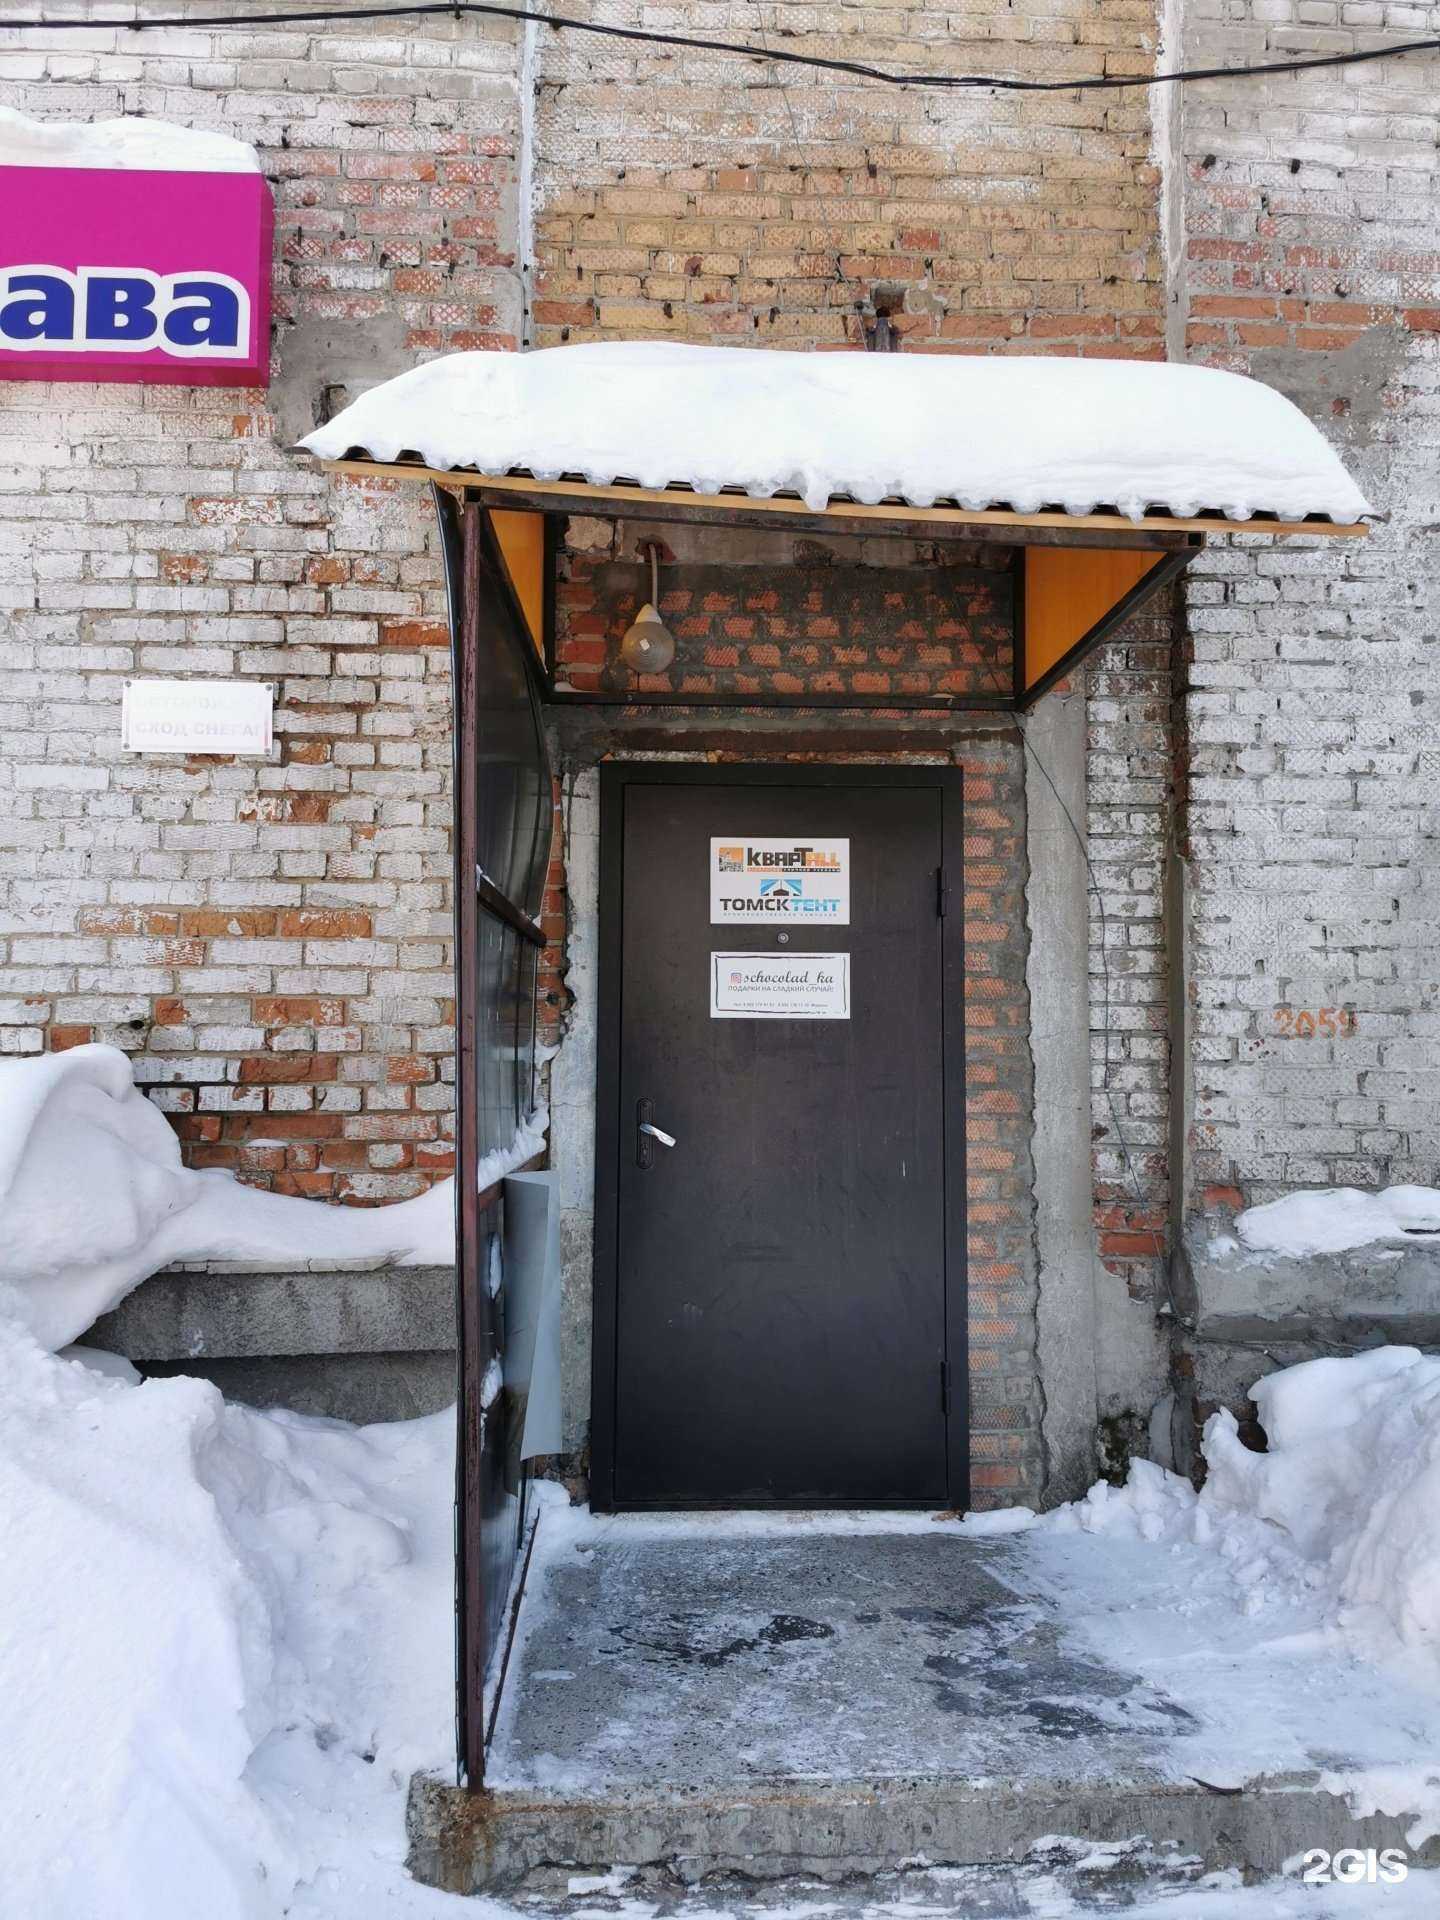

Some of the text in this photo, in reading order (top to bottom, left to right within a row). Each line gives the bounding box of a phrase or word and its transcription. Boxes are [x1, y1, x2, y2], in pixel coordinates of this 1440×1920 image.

[728, 985, 761, 993] ПОДАРКИ
[761, 985, 772, 993] НА
[773, 985, 805, 993] СЛАДКИЙ
